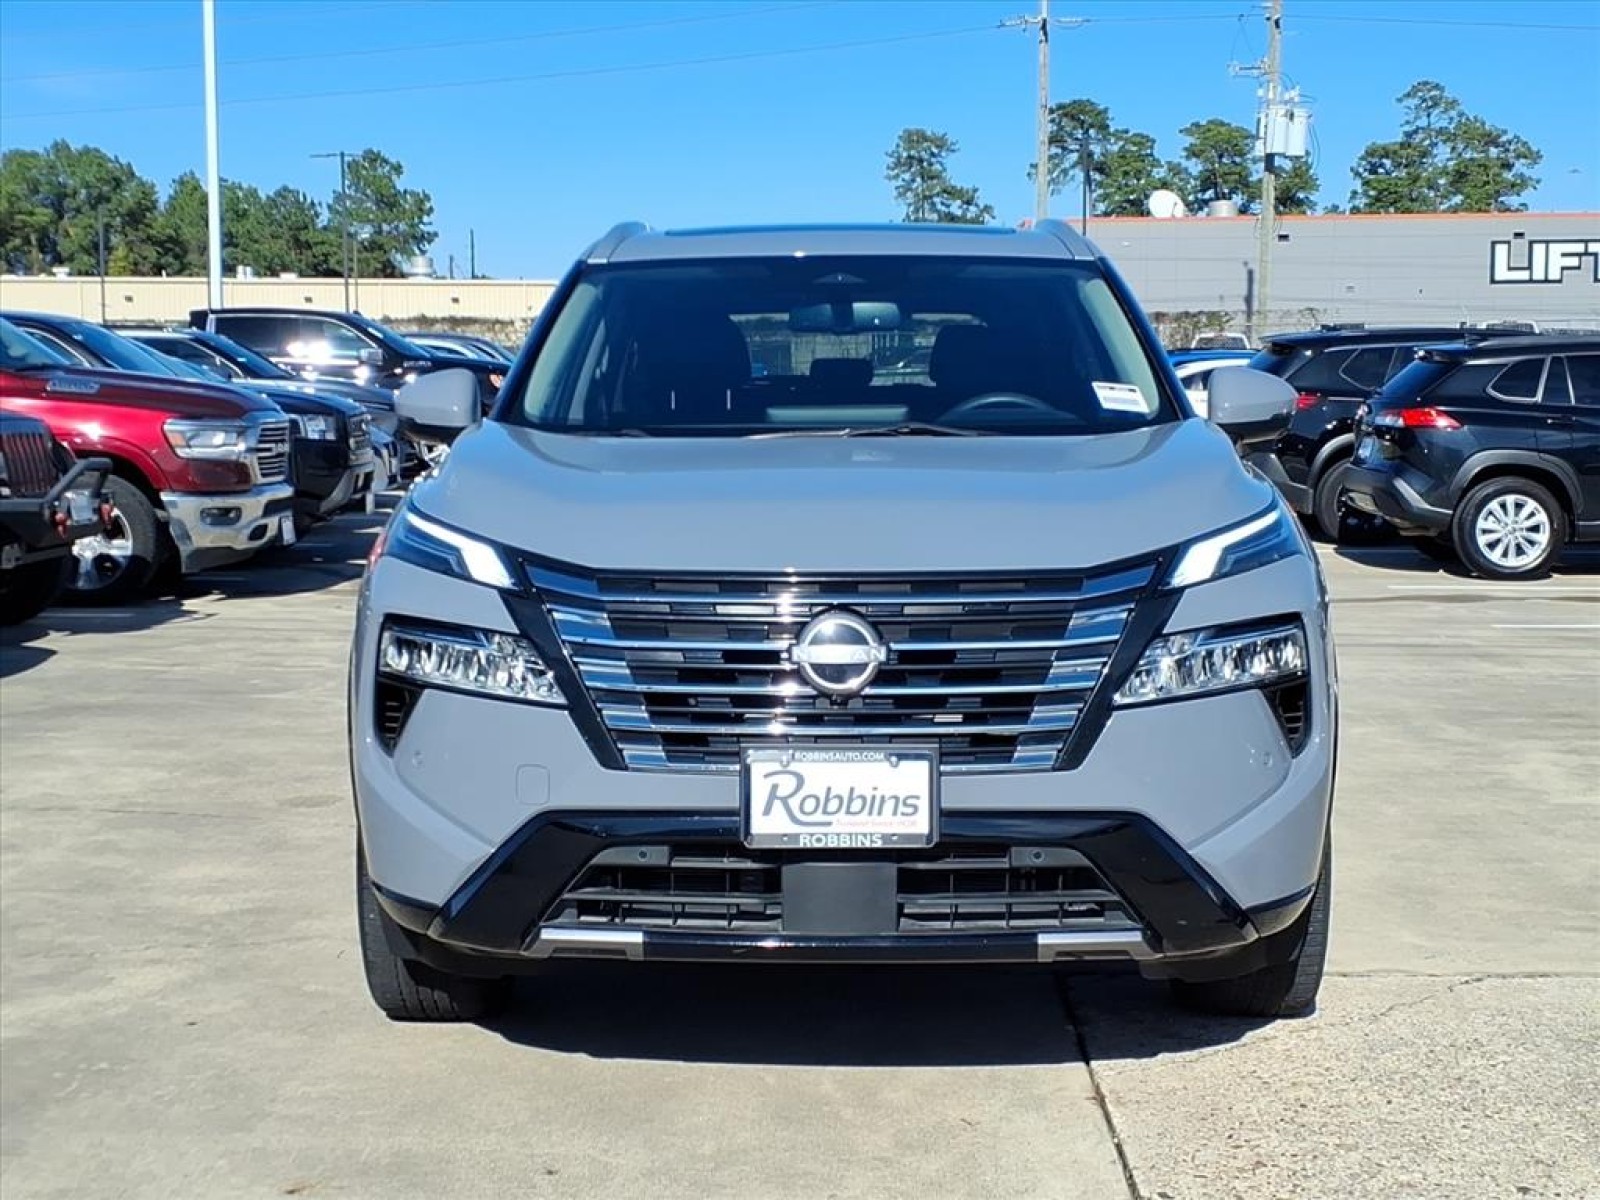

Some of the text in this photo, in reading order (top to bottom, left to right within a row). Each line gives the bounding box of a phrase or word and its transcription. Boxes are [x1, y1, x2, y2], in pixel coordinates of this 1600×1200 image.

[794, 751, 884, 763] ROBBINSAUTO.COM
[762, 770, 921, 827] Robbins
[799, 834, 884, 847] ROBBINS
